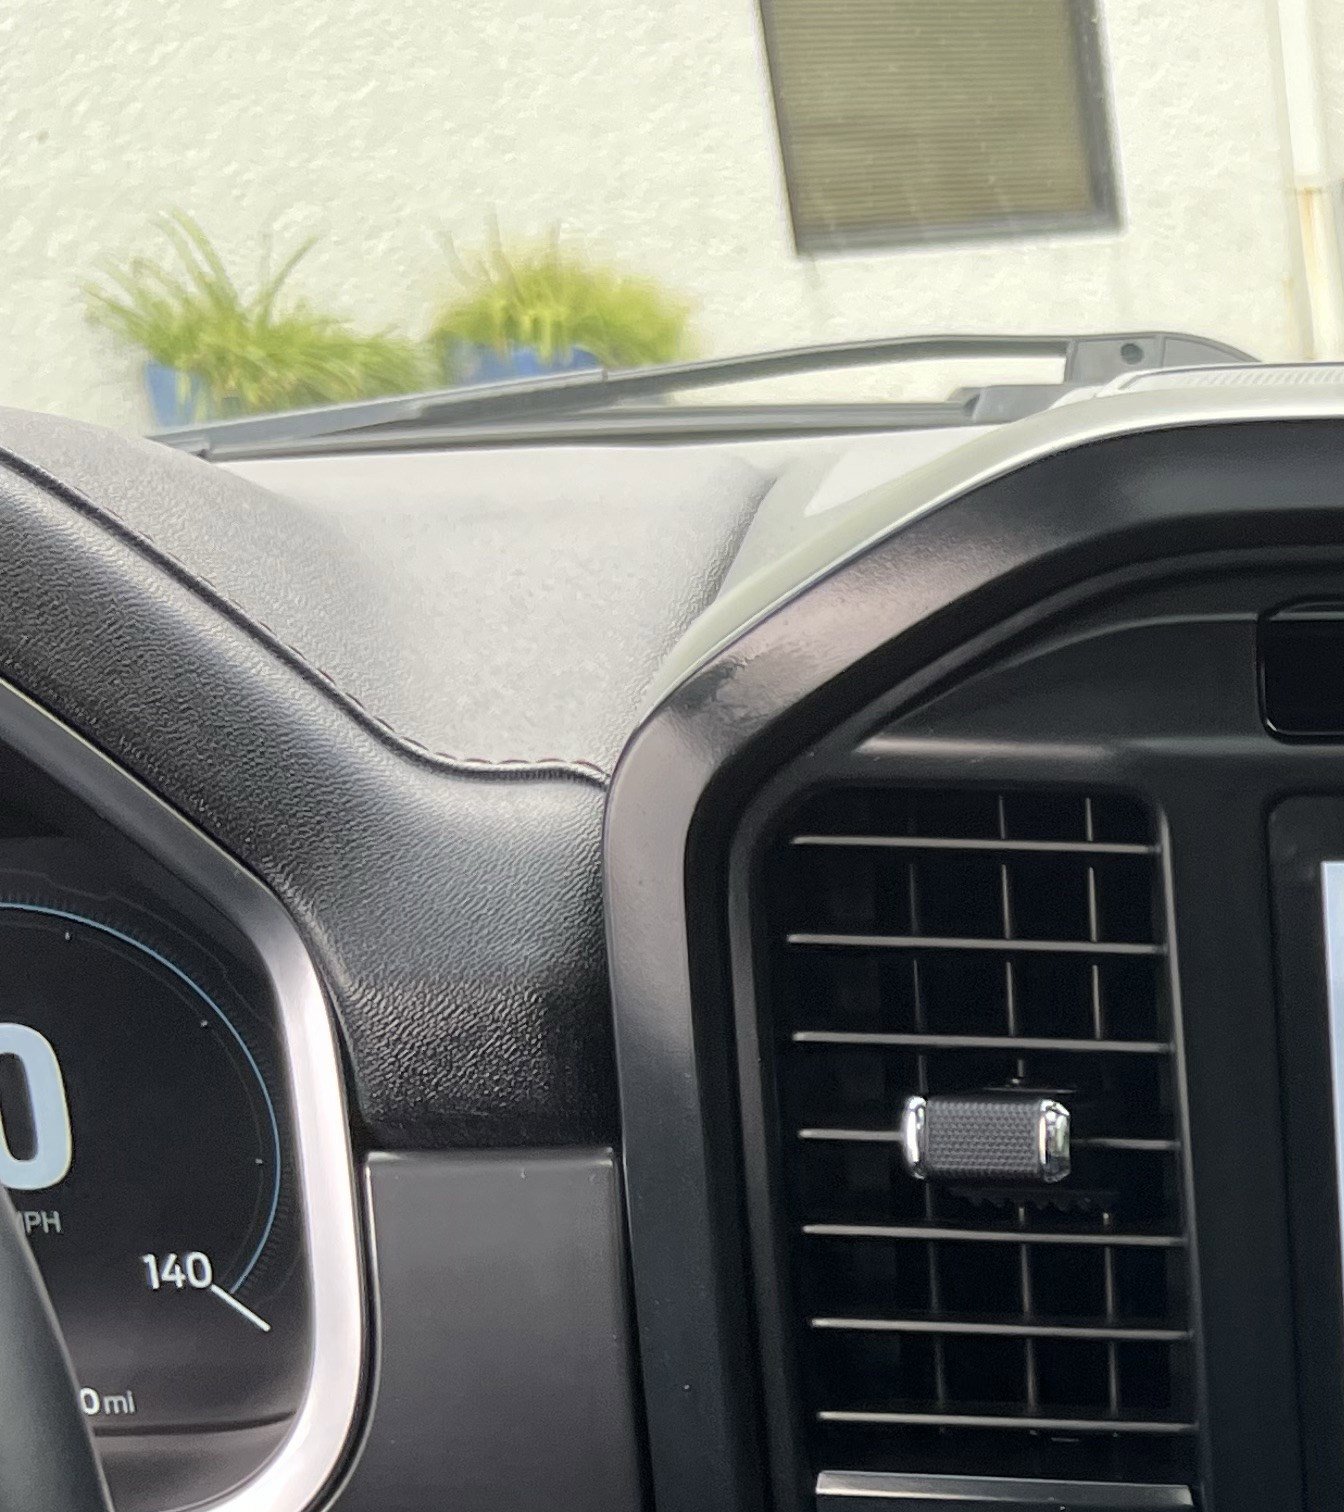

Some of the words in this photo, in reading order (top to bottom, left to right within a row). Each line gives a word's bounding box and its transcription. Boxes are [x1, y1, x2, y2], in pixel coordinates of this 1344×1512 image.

[16, 1211, 62, 1234] PH
[142, 1252, 213, 1290] 140
[103, 1389, 136, 1415] mi
